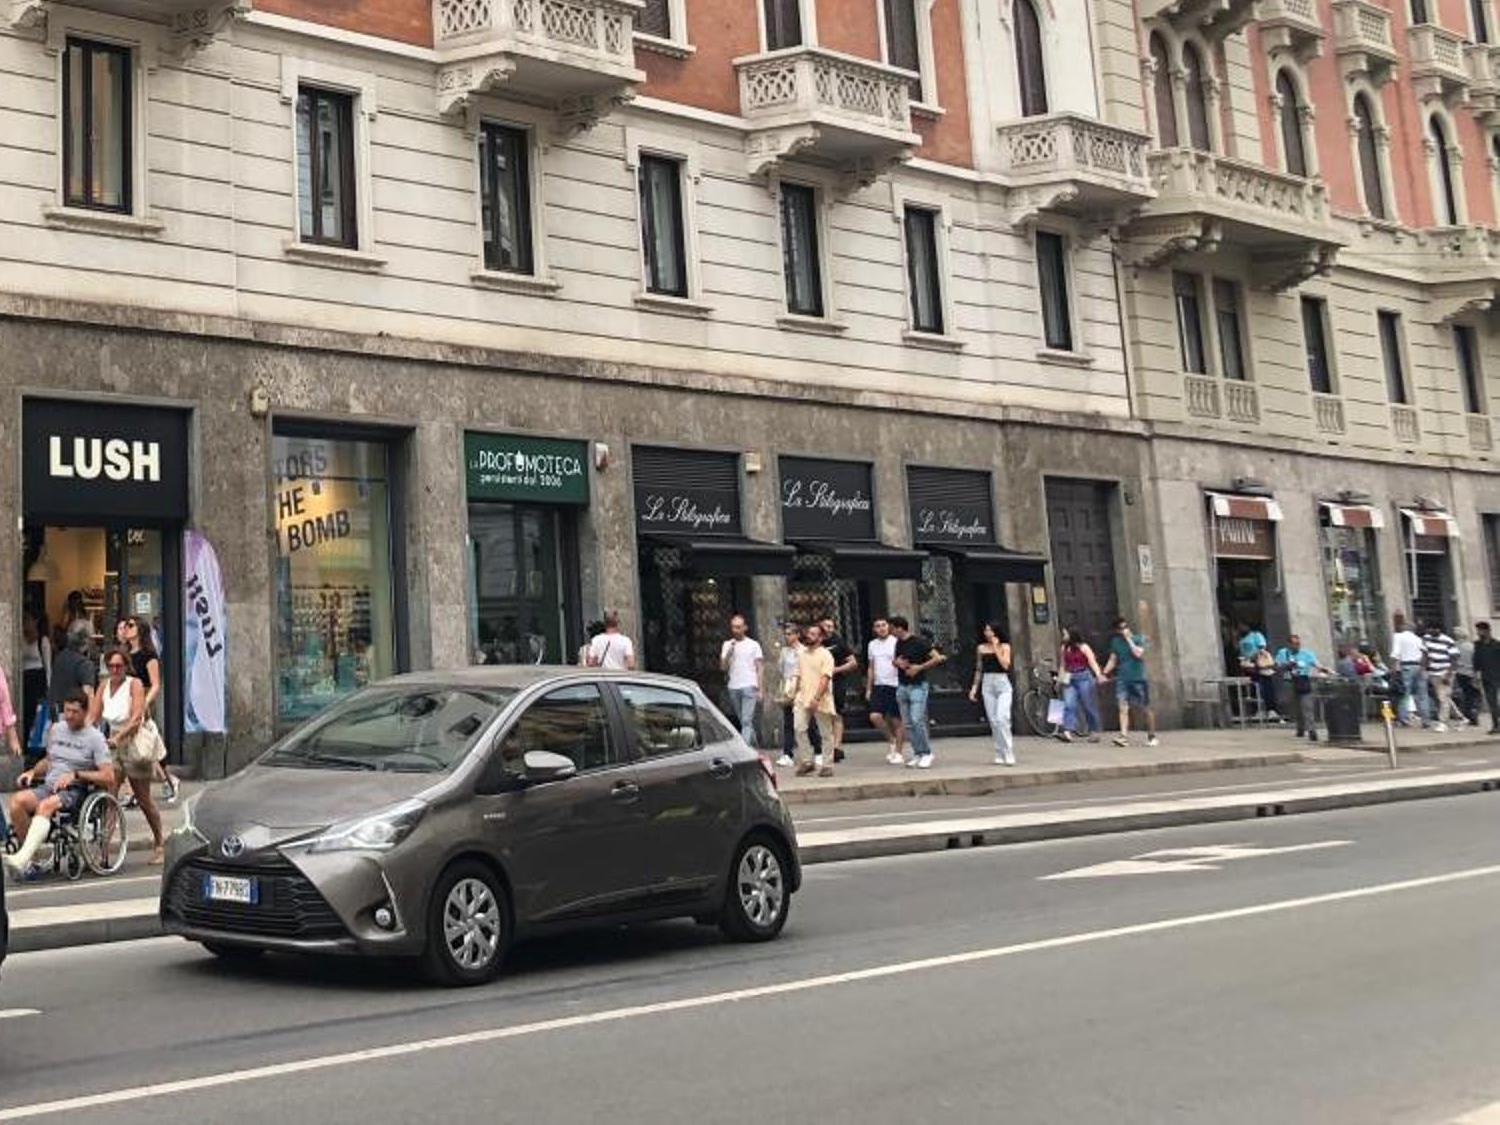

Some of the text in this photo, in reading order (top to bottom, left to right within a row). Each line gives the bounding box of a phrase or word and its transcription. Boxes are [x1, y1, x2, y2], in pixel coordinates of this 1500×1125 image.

[49, 436, 161, 482] LUSH
[641, 495, 665, 523] La
[783, 479, 802, 508] La
[287, 509, 351, 552] BOMB
